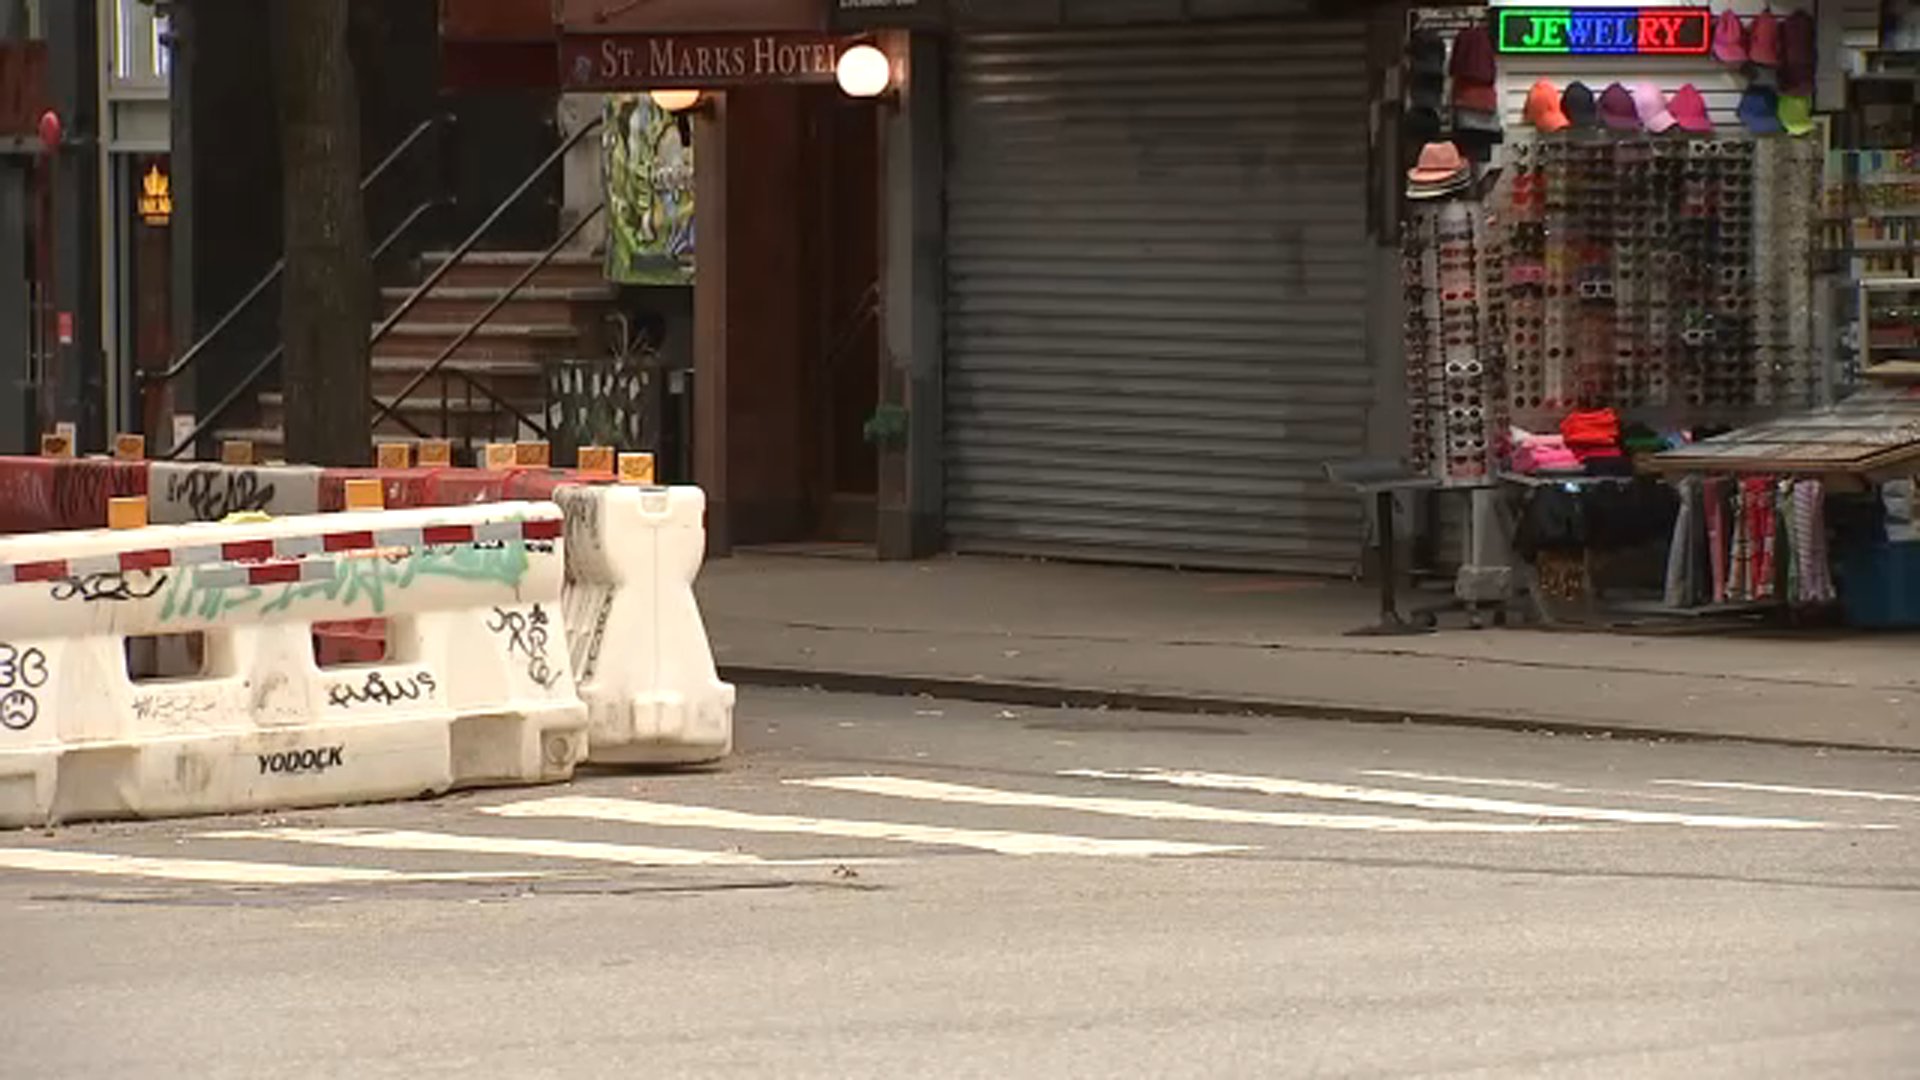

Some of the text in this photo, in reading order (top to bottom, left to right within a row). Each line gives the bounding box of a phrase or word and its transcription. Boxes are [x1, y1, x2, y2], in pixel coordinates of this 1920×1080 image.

[1522, 16, 1686, 46] JEWELRY
[650, 39, 745, 77] MARKS
[257, 746, 344, 775] YODOCK
